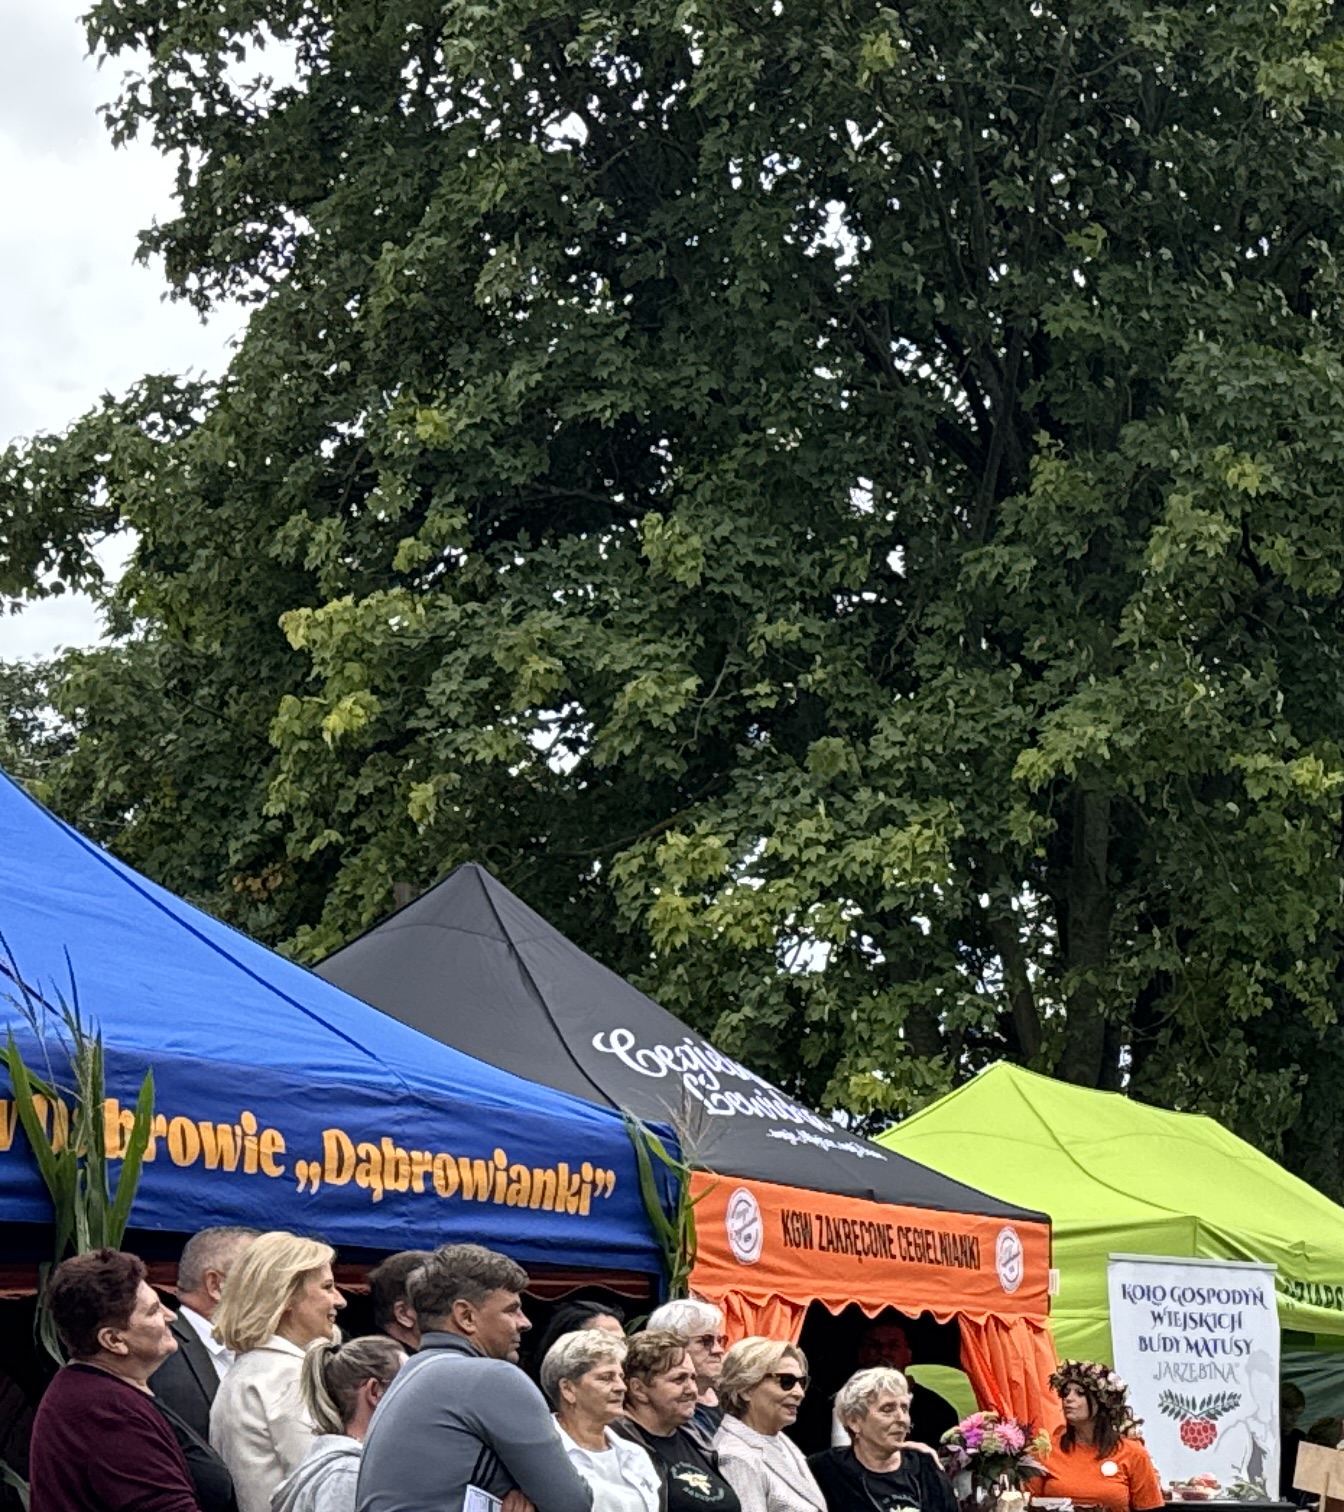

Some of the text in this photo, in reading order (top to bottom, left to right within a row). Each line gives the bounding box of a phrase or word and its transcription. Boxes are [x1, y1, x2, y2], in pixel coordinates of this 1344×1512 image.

[781, 1208, 981, 1271] KGW ZAKRĘCONE CEGIELNIANKI
[1121, 1283, 1270, 1310] KOŁO GOSPODYŃ
[1151, 1306, 1244, 1333] WIEJSKICH
[1138, 1333, 1254, 1358] BUDY MATUSY
